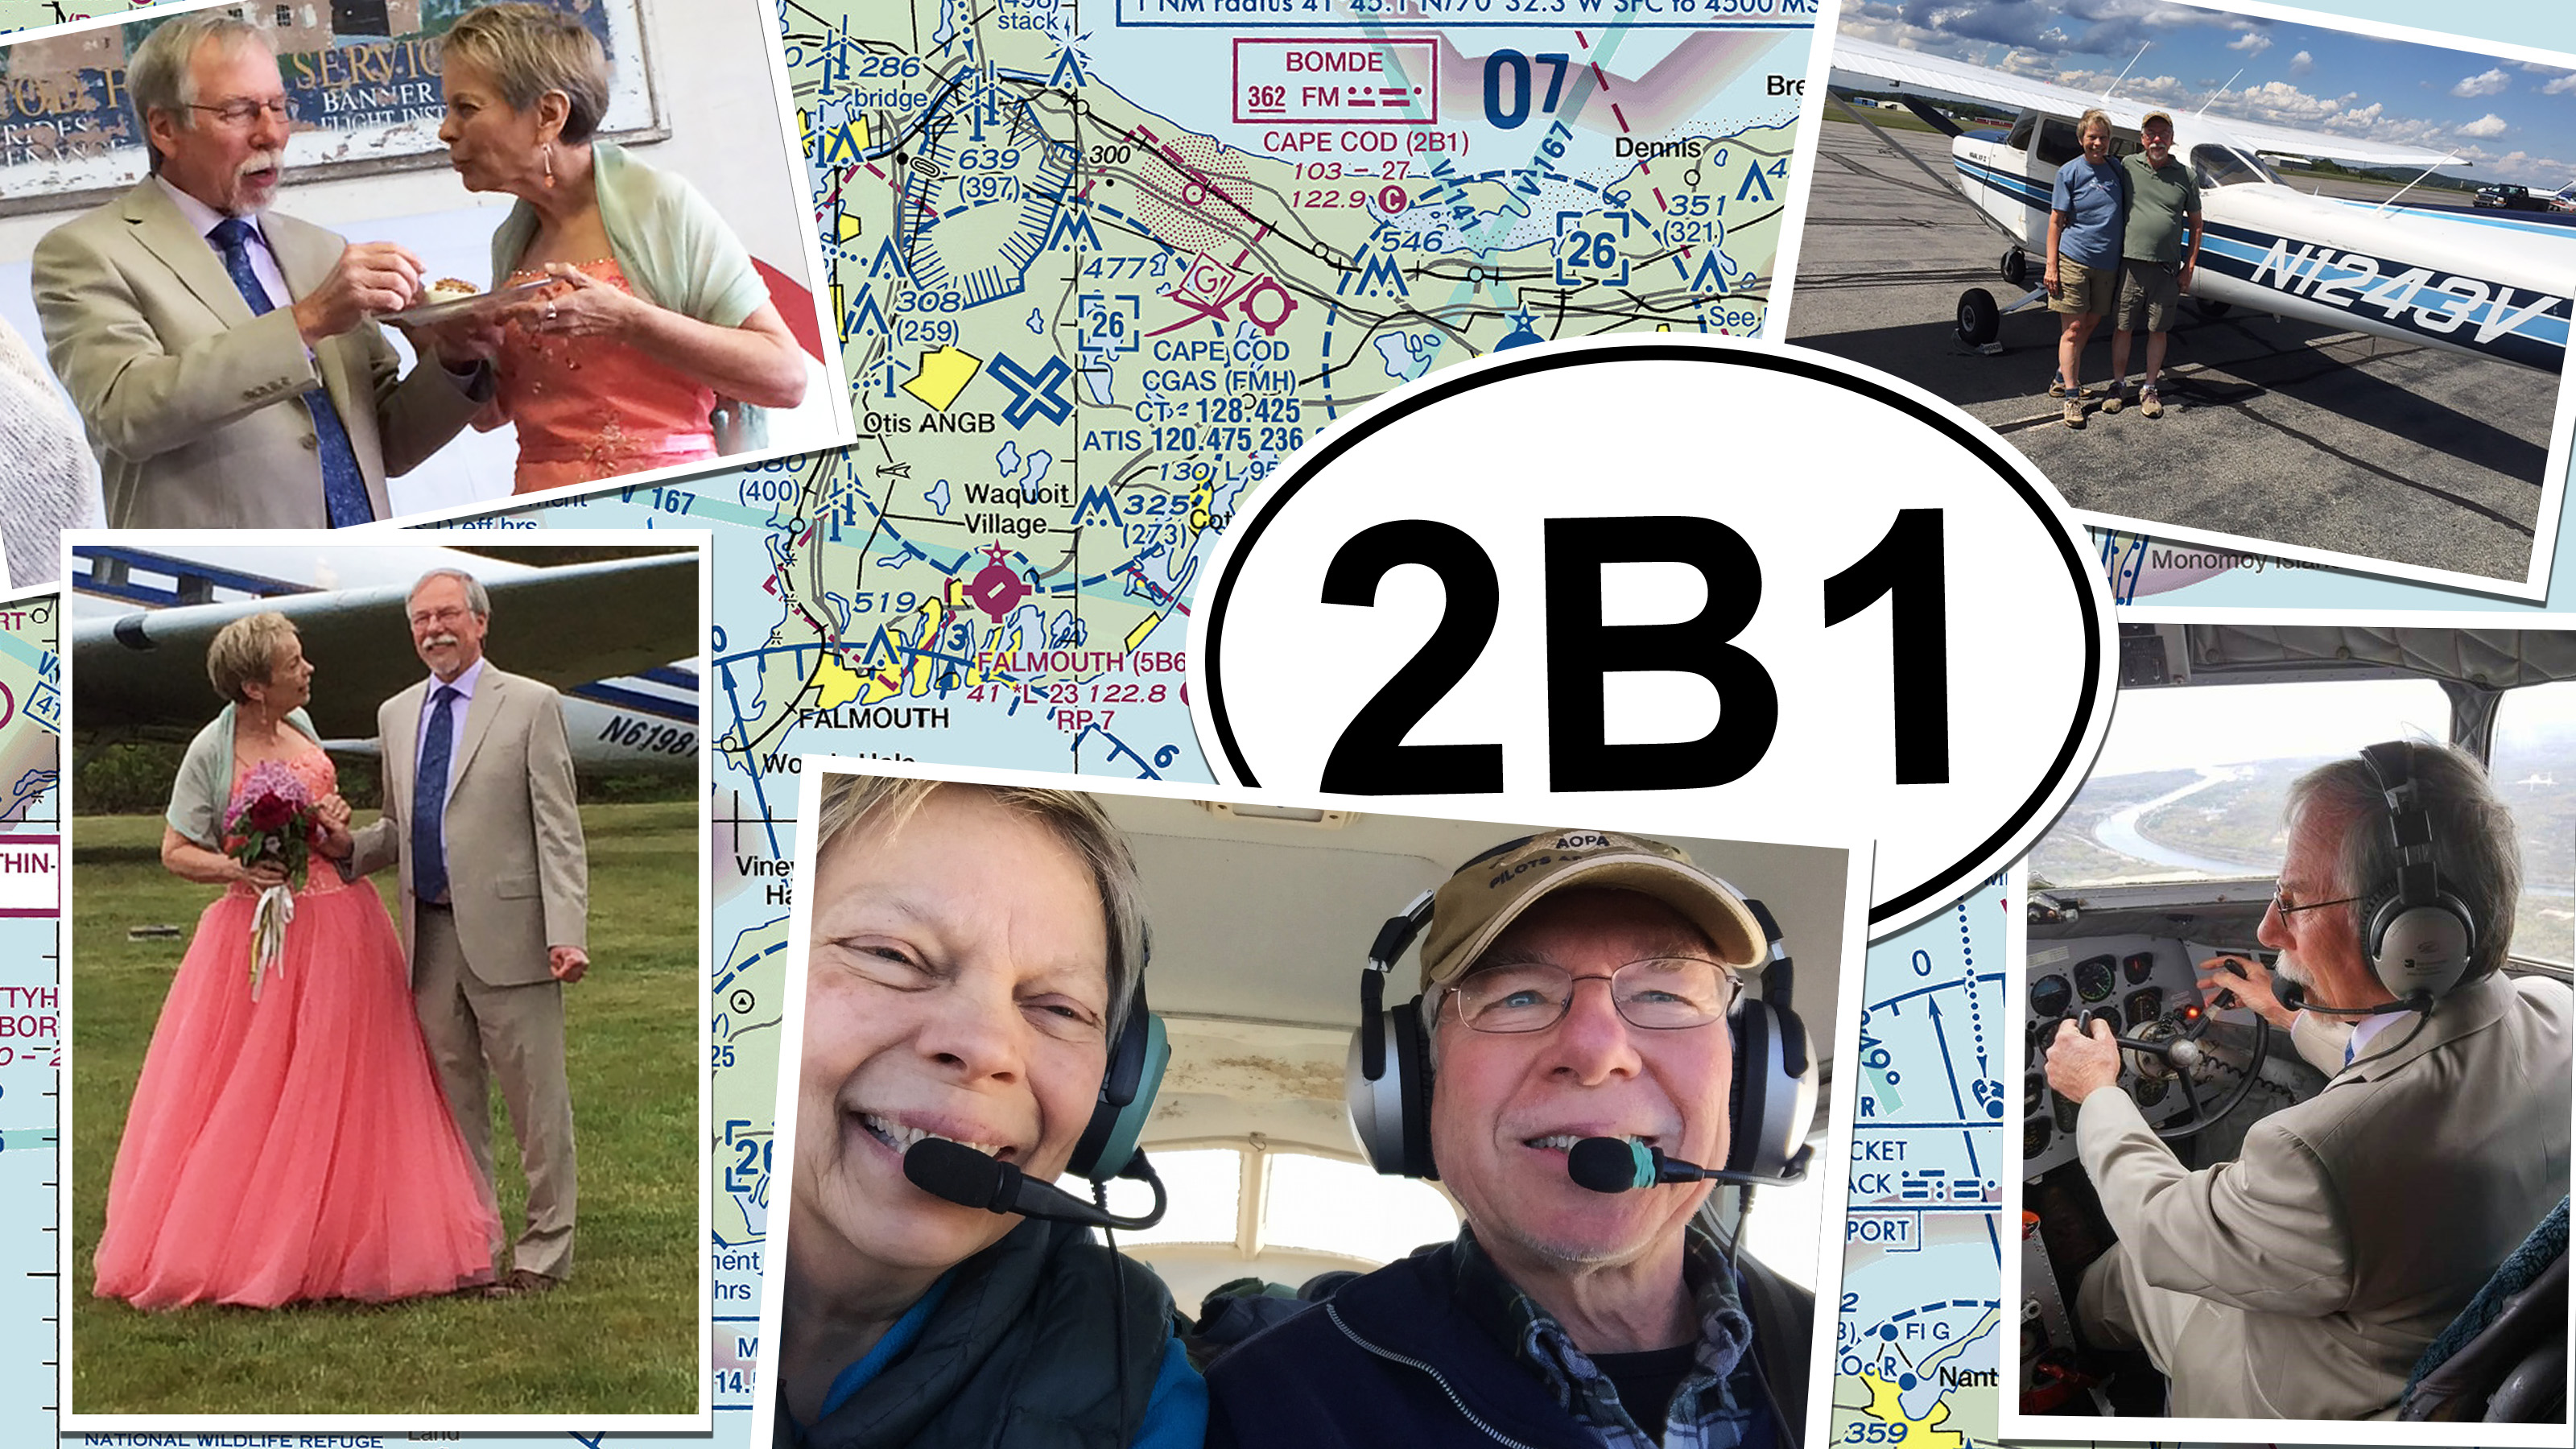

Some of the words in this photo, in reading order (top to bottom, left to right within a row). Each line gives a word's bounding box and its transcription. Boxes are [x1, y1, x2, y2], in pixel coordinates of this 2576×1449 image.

[998, 11, 1059, 30] stack
[859, 56, 920, 77] 286
[1286, 52, 1384, 72] BOMDE
[323, 81, 436, 113] BANNER
[854, 89, 927, 111] bridge
[1248, 86, 1286, 109] 362
[1302, 87, 1340, 107] FM
[1483, 48, 1569, 130] 07
[320, 109, 395, 133] FLIGHT
[1263, 131, 1331, 152] CAPE
[1340, 131, 1398, 152] COD
[1406, 130, 1470, 157] (2B1)
[1534, 120, 1574, 171] 167
[1616, 137, 1701, 158] Dennis
[965, 149, 1021, 170] 639
[1090, 146, 1131, 164] 300
[1293, 163, 1343, 181] 103
[1382, 161, 1410, 180] 27
[959, 175, 1021, 203] (397)
[1292, 191, 1366, 208] 122.9
[1668, 195, 1727, 217] 351
[1380, 230, 1444, 253] 546
[1663, 219, 1724, 248] (321)
[1568, 232, 1617, 269] 26
[1084, 257, 1148, 279] 477
[895, 291, 962, 312] 308
[2250, 238, 2563, 345] N1243V
[1092, 311, 1125, 338] 26
[1709, 306, 1756, 327] See
[897, 319, 960, 347] (259)
[1153, 340, 1225, 361] CAPE
[1232, 340, 1290, 361] COD
[1142, 370, 1216, 391] CGAS
[1224, 369, 1297, 395] (FMH)
[1135, 402, 1170, 423] CT
[1196, 398, 1301, 423] 128.425
[864, 412, 912, 433] Otis
[919, 412, 996, 433] ANGB
[1083, 431, 1141, 452] ATIS
[1151, 427, 1253, 452] 120.475
[1260, 427, 1303, 452] 236
[651, 486, 696, 516] 167
[739, 479, 800, 506] (400)
[964, 484, 1069, 508] Waquoit
[1123, 494, 1190, 515] 325
[964, 513, 1048, 539] Village
[1123, 522, 1187, 549] (273)
[852, 592, 917, 613] 519
[977, 651, 1125, 672] FALMOUTH
[966, 684, 999, 703] 41
[1050, 684, 1079, 704] 23
[1090, 684, 1166, 703] 122.8
[799, 708, 950, 729] FALMOUTH
[1057, 710, 1094, 730] RP
[1100, 710, 1115, 730] 7
[1555, 835, 1610, 849] AOPA
[0, 853, 49, 873] HIN
[1489, 855, 1552, 889] PILOTS
[715, 1279, 751, 1300] hrs
[715, 1371, 755, 1393] 14.
[85, 1433, 191, 1447] NATIONAL
[197, 1434, 293, 1448] WILDLIFE
[300, 1435, 383, 1449] REFUGE
[1843, 1422, 1909, 1444] 359
